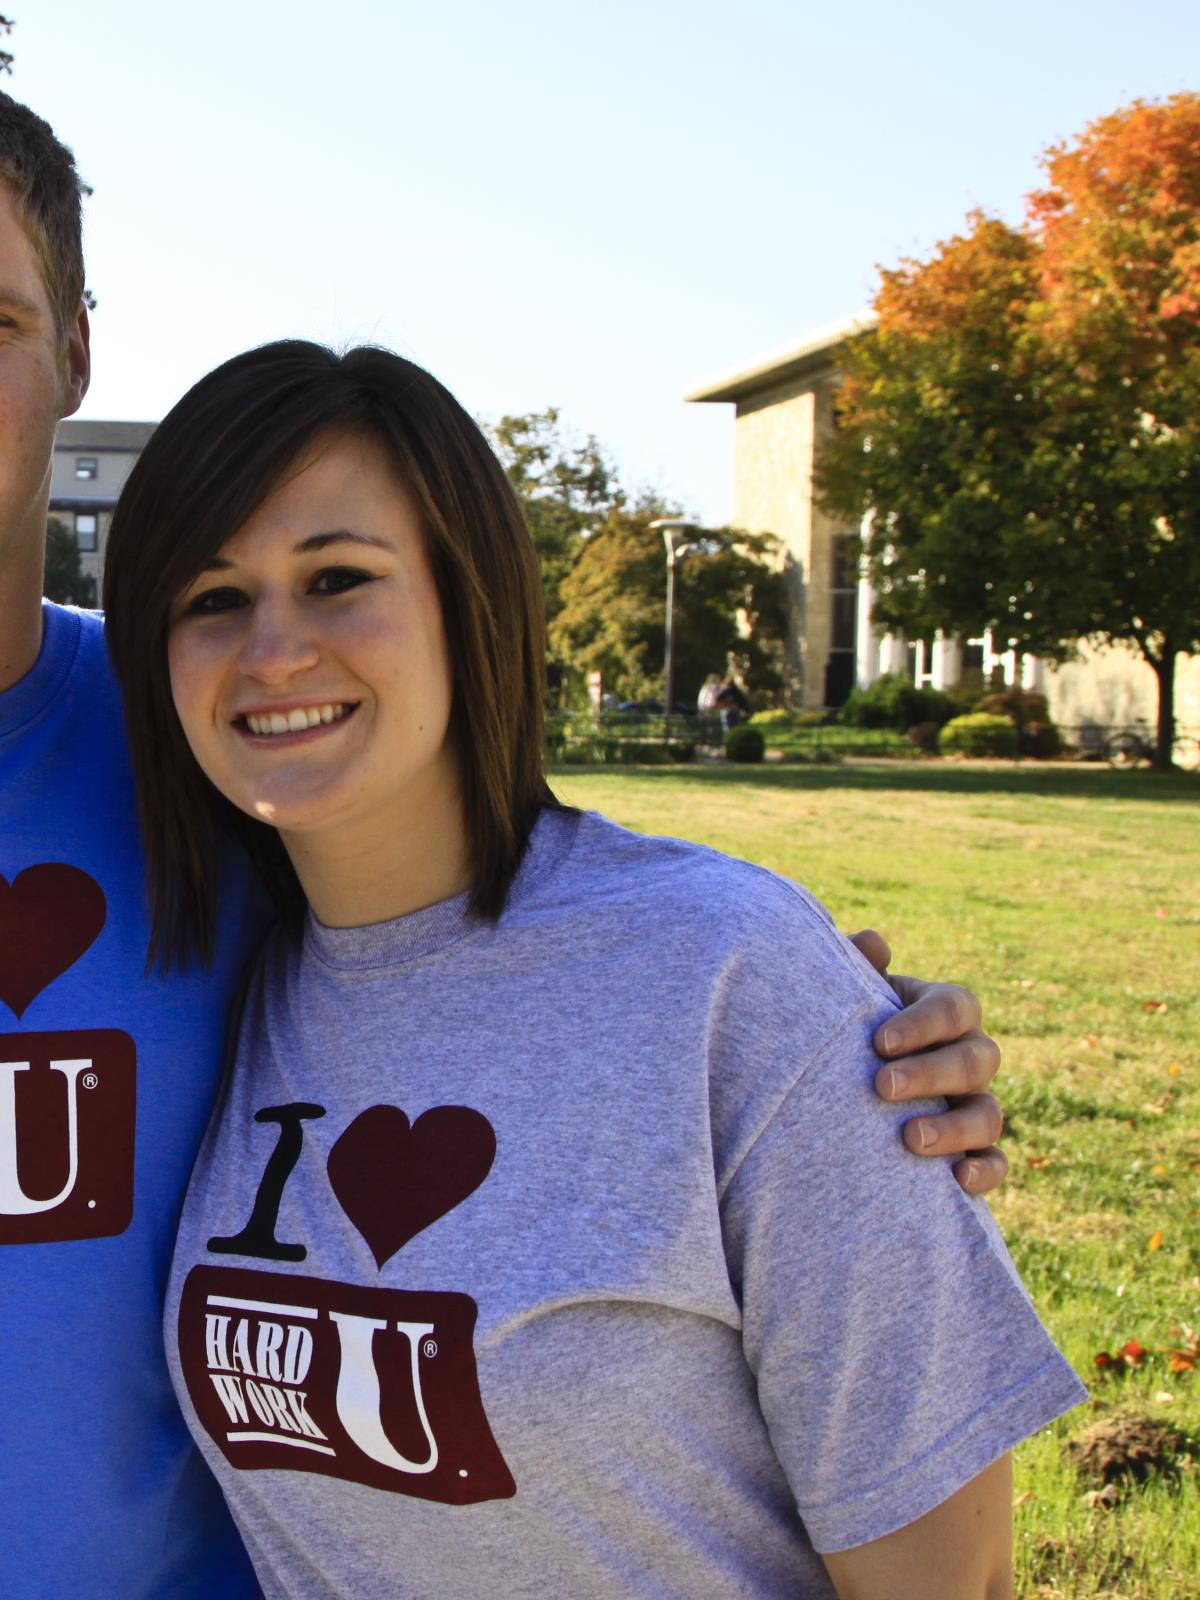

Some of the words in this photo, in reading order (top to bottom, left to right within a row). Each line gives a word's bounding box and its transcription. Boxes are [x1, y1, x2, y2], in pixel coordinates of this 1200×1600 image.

[206, 1102, 326, 1262] I
[205, 1313, 314, 1385] HARD
[209, 1374, 329, 1441] WORK
